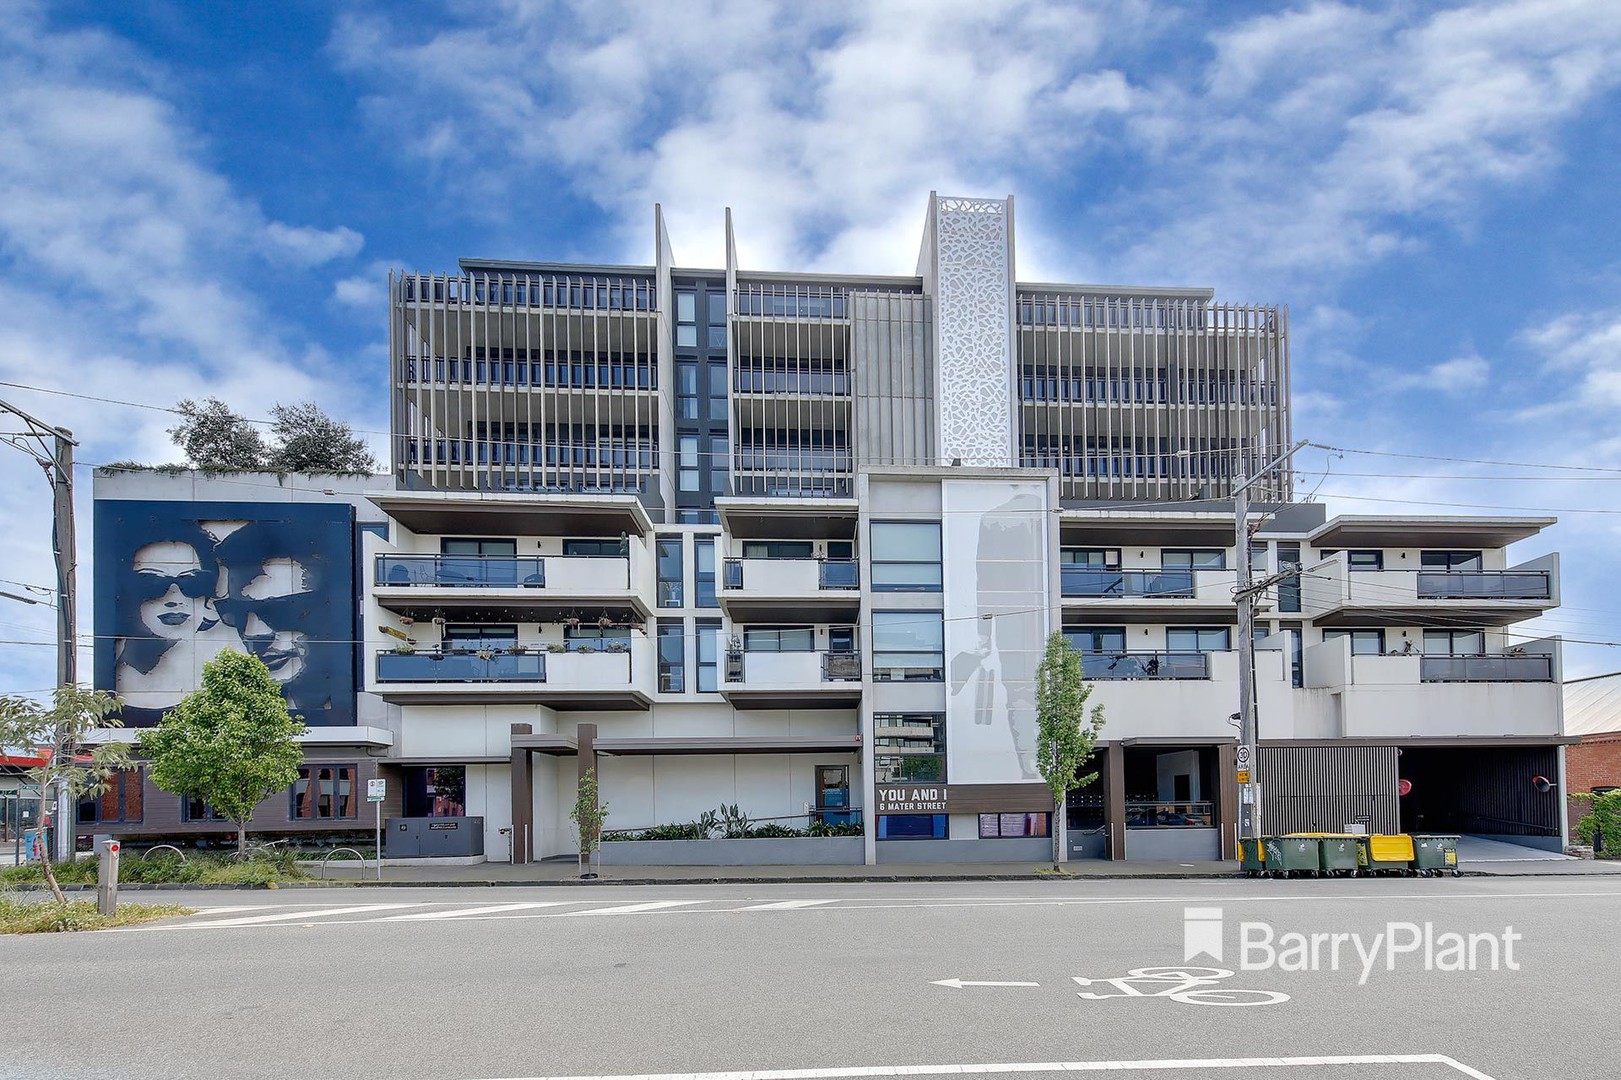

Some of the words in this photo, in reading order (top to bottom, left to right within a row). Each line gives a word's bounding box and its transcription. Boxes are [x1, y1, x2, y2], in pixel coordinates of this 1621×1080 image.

[879, 789, 906, 801] YOU
[911, 789, 938, 801] AND
[944, 789, 947, 800] I
[917, 802, 946, 810] STREET
